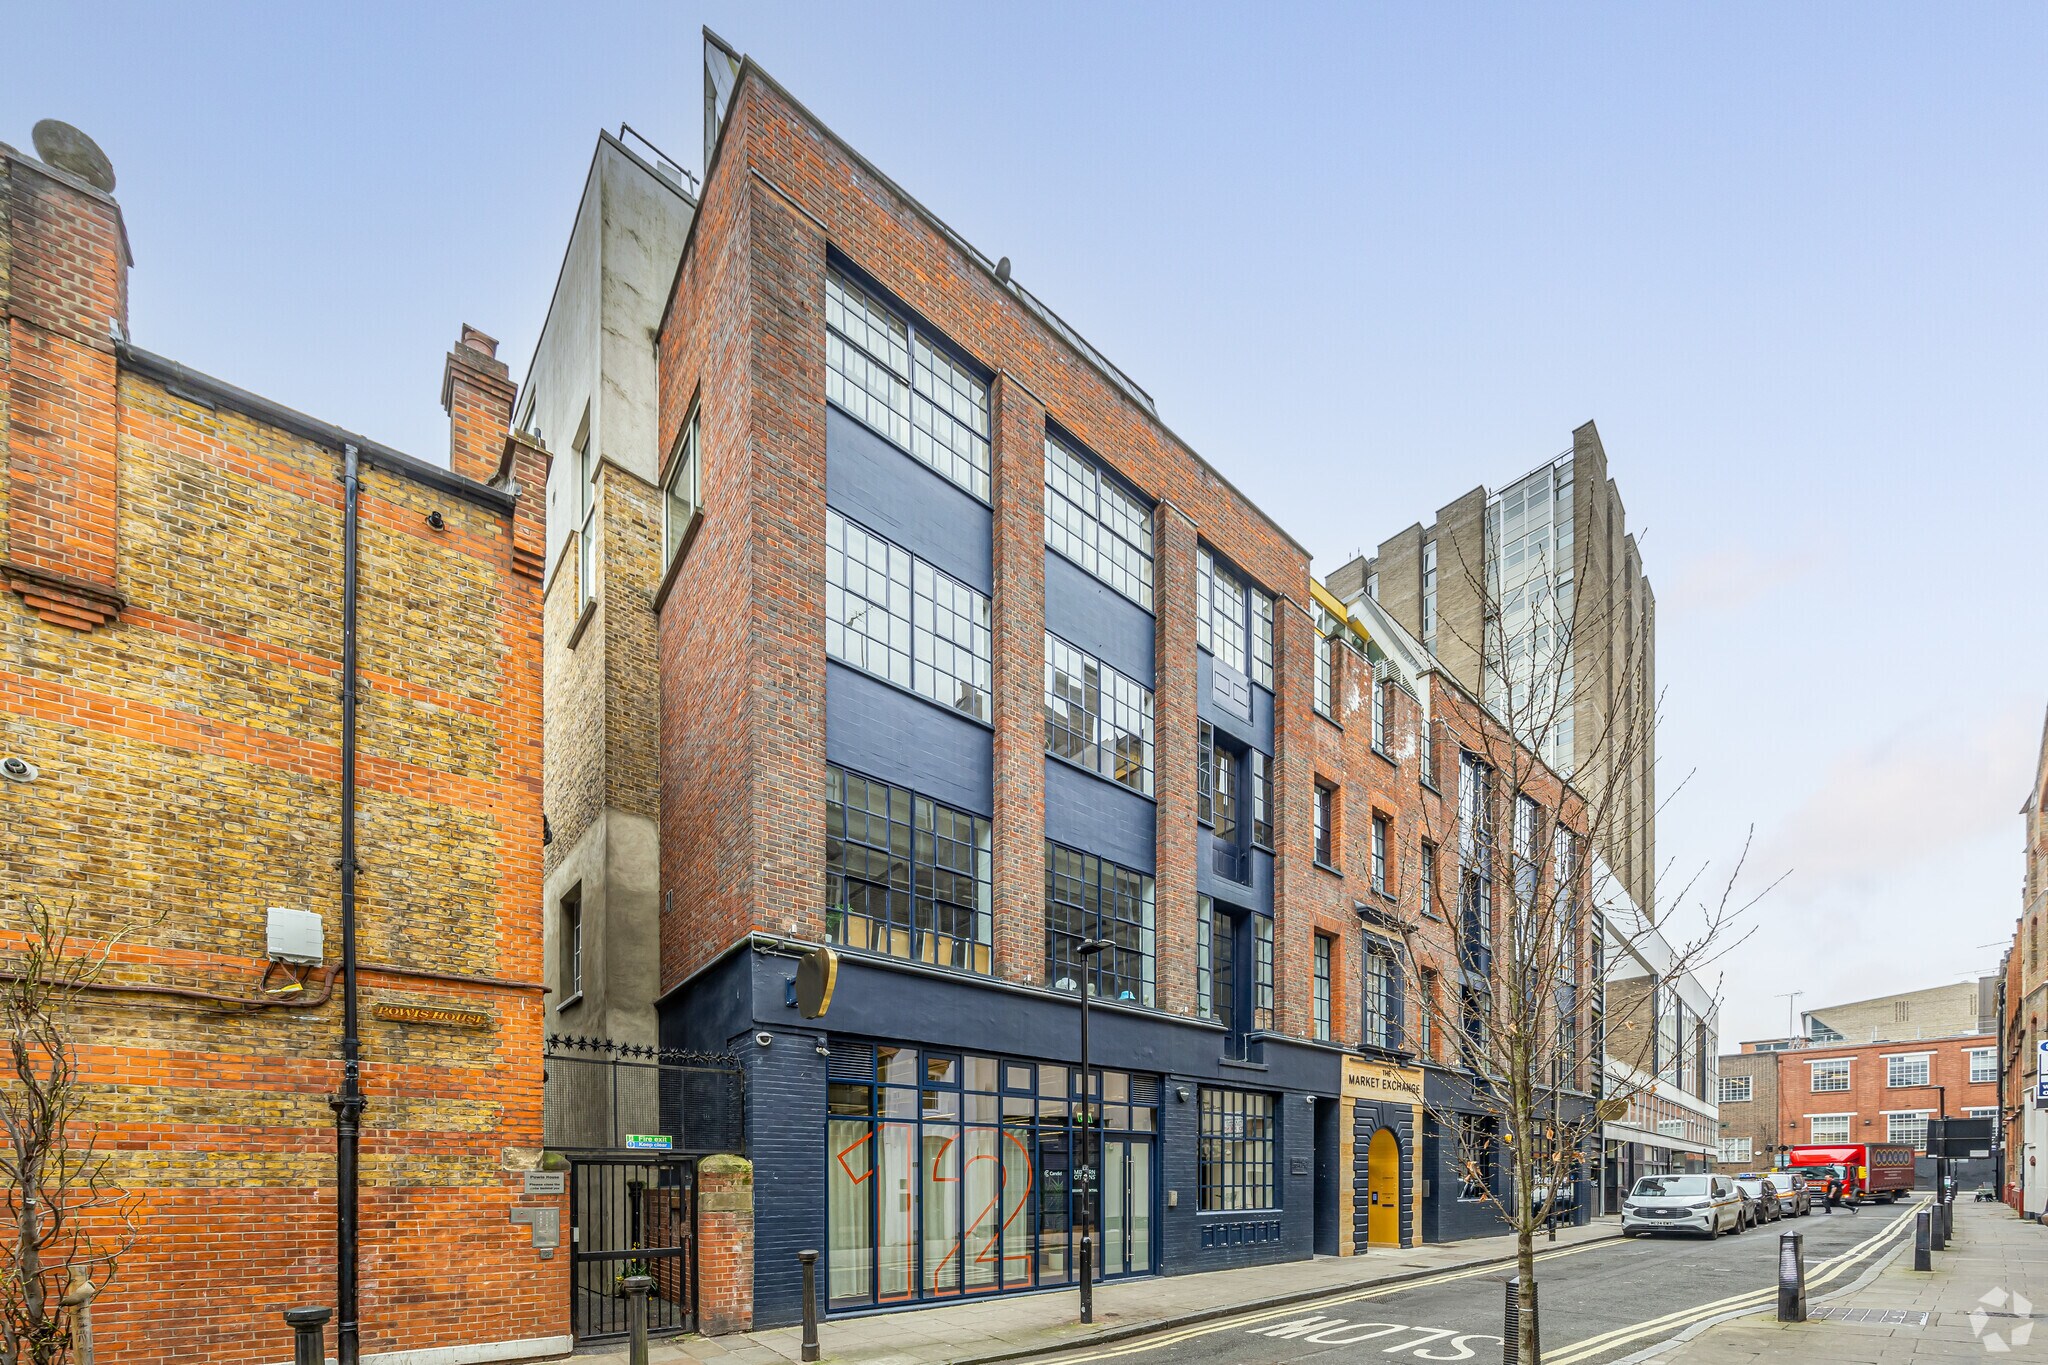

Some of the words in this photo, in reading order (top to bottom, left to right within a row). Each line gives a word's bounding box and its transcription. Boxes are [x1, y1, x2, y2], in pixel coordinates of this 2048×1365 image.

[378, 1006, 429, 1018] POWIS
[431, 1011, 487, 1023] HOUSE
[1382, 1069, 1391, 1077] THE
[1348, 1074, 1379, 1088] MARKET
[1382, 1079, 1420, 1094] EXCHANGE
[837, 1123, 1032, 1303] 12
[1245, 1316, 1505, 1361] SLOW
